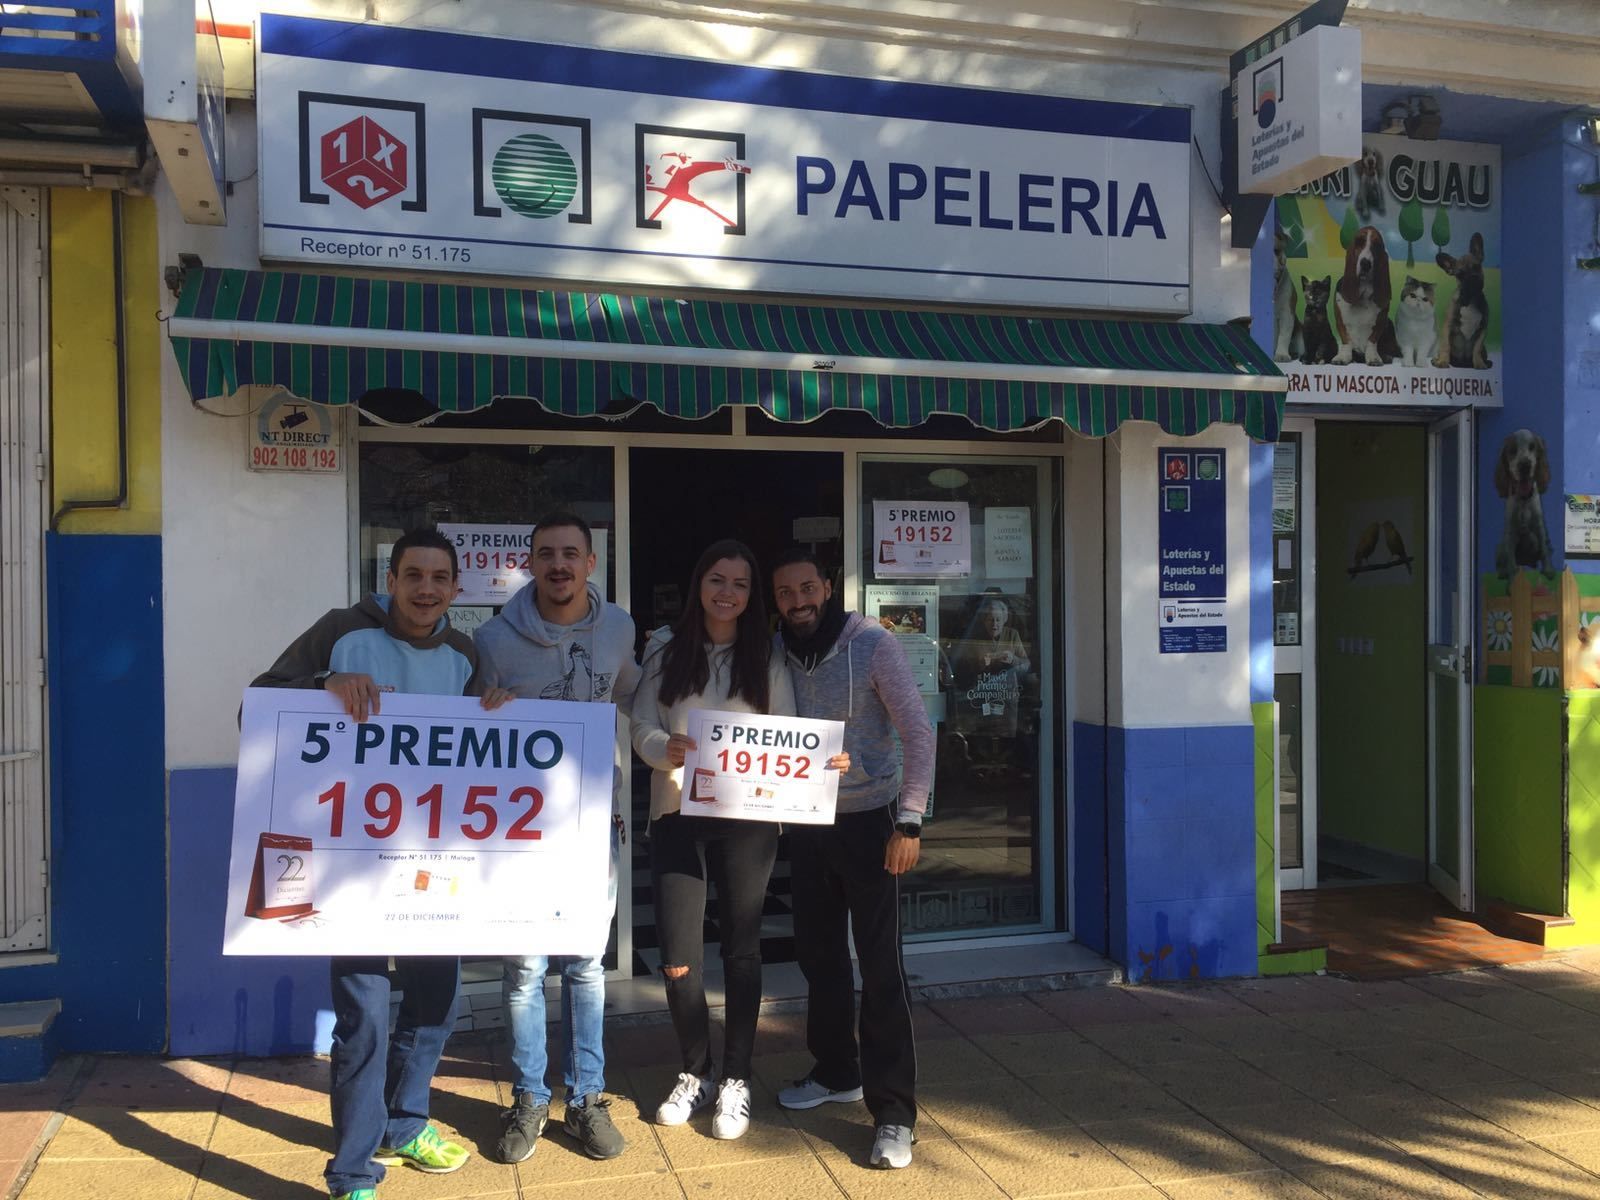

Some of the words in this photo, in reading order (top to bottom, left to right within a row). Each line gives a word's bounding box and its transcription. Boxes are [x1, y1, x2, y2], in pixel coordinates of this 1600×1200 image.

[1388, 153, 1492, 207] GUAU
[796, 155, 1167, 240] PAPELERIA
[301, 237, 382, 258] Receptor
[412, 244, 471, 263] 51.175
[1314, 374, 1332, 392] TU
[1337, 375, 1400, 394] MASCOTA
[1411, 377, 1493, 399] PELUQUERIA
[283, 431, 330, 443] DIRECT
[253, 447, 278, 466] 902
[283, 448, 307, 467] 108
[312, 449, 336, 468] 192
[901, 509, 956, 522] PREMIO
[894, 525, 953, 543] 19152
[461, 551, 531, 570] 19152
[1163, 565, 1207, 578] Apuestas
[1209, 564, 1224, 575] del
[1163, 581, 1196, 592] Estado
[354, 722, 564, 770] PREMIO
[732, 725, 821, 750] PREMIO
[717, 749, 811, 779] 19152
[318, 781, 545, 841] 19152
[276, 854, 305, 882] 22
[378, 853, 407, 861] Receptor
[413, 913, 461, 921] DICIEMBRE
